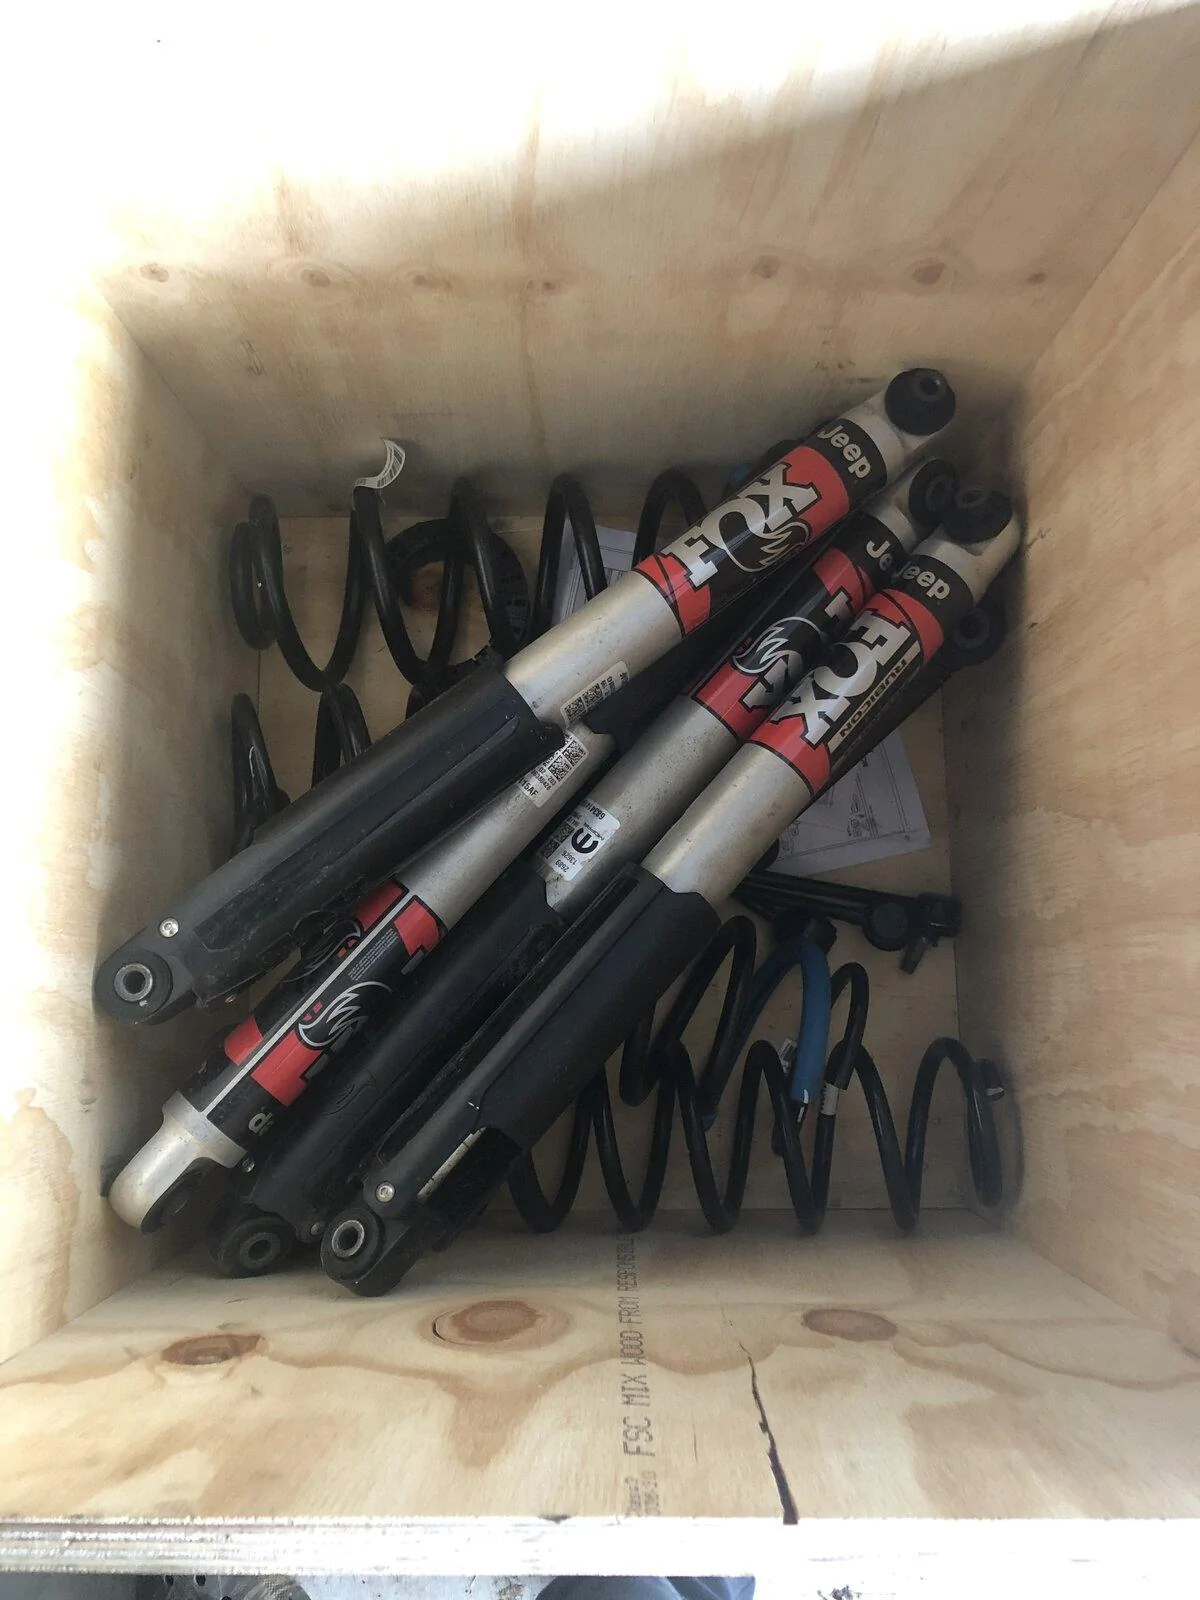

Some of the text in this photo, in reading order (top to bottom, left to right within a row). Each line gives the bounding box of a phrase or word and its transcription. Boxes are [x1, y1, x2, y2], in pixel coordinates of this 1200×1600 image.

[817, 425, 871, 478] Jeep
[661, 462, 818, 588] FOX
[769, 610, 912, 744] FOX
[840, 657, 907, 738] RUBICON
[618, 1296, 642, 1324] FROM
[619, 1330, 647, 1365] WOOD
[620, 1373, 650, 1407] MIX
[622, 1416, 656, 1457] FSC
